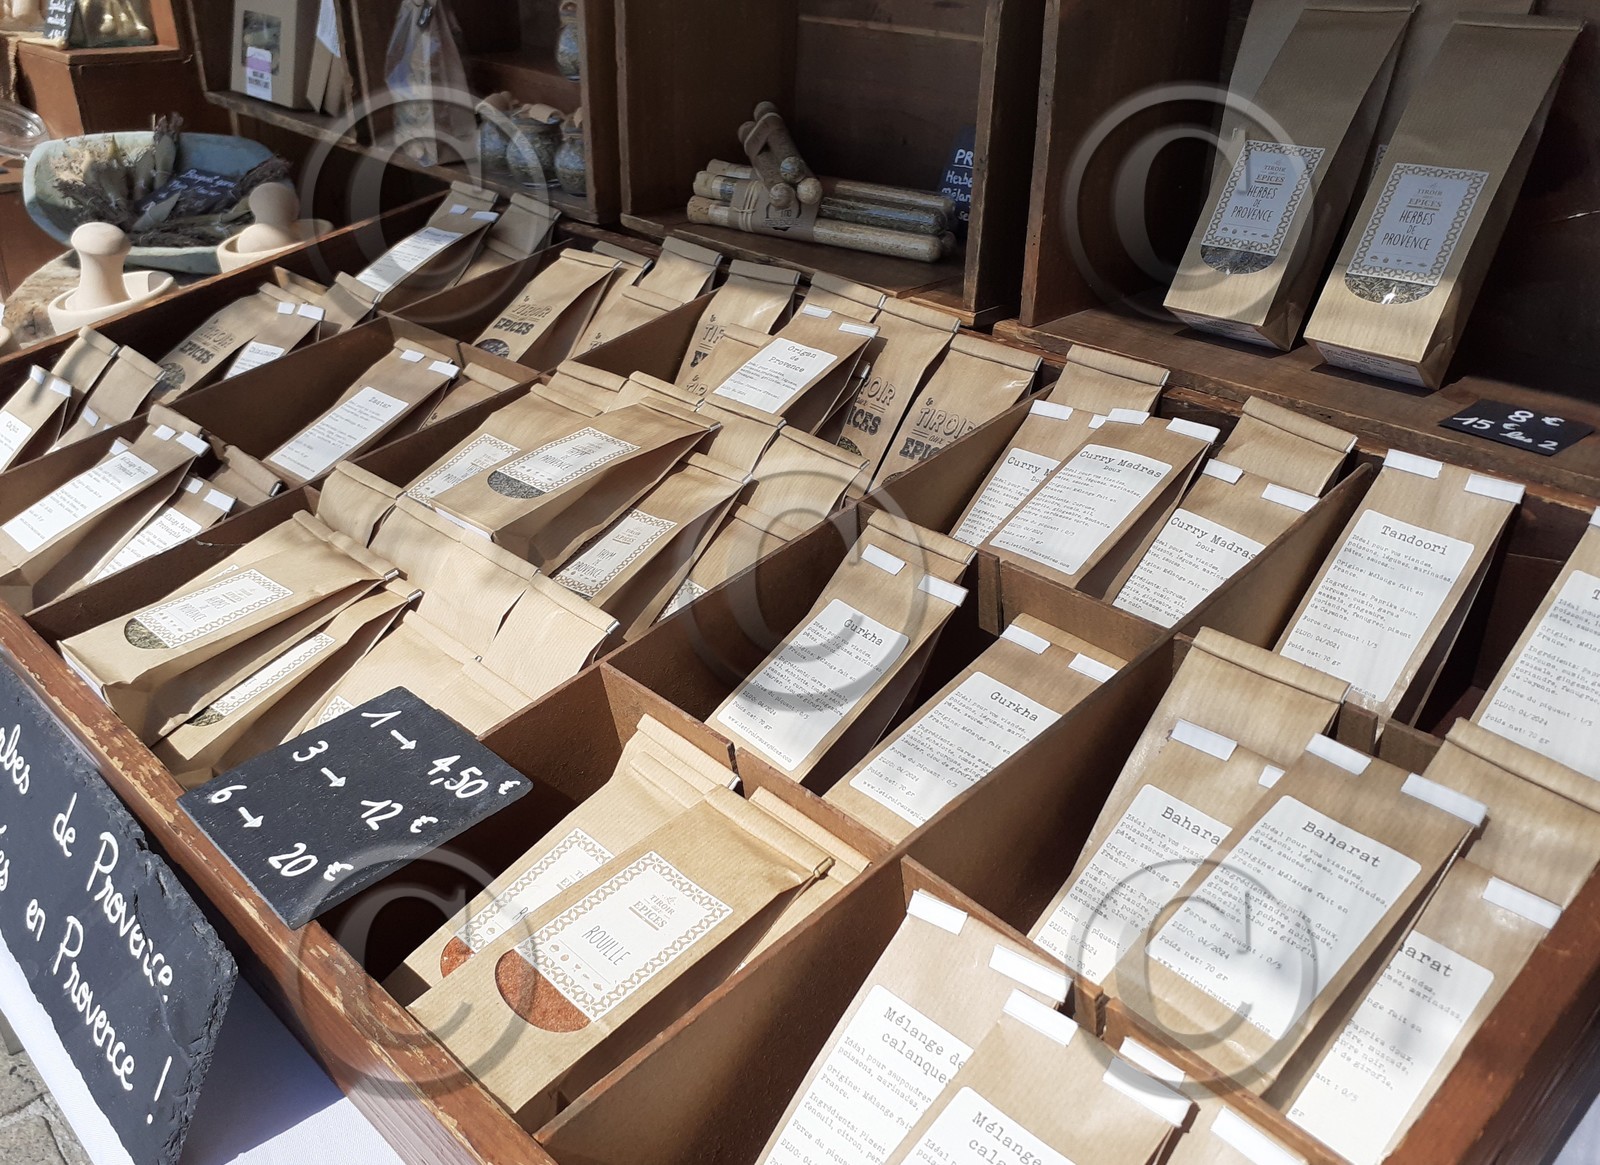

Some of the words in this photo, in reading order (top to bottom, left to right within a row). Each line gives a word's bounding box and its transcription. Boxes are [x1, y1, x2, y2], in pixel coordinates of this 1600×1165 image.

[1247, 185, 1278, 199] HERBES
[1253, 199, 1262, 207] DE
[1231, 206, 1274, 222] PROVENCE
[1399, 210, 1435, 226] HERBES
[1381, 232, 1432, 250] PROVENCE
[1407, 225, 1416, 234] DE
[493, 318, 535, 335] EPICES
[768, 356, 804, 372] Provence
[787, 345, 816, 359] Origan
[1508, 410, 1534, 422] 8
[1541, 416, 1566, 426] €
[1452, 416, 1495, 430] 15
[1538, 440, 1558, 450] 2
[1004, 456, 1041, 474] Curry
[1077, 450, 1117, 465] Curry
[1117, 460, 1166, 477] Madras
[1102, 465, 1123, 473] Doux
[1167, 516, 1209, 540] Curry
[1210, 534, 1259, 561] Madras
[1194, 541, 1217, 553] Doux
[1379, 525, 1451, 555] Tandoori
[841, 618, 886, 646] Gurkha
[988, 691, 1043, 722] Gurkha
[361, 710, 402, 728] 1
[427, 754, 489, 798] 4,50
[498, 780, 522, 796] €
[292, 740, 330, 762] 3
[360, 800, 404, 830] 12
[410, 815, 440, 834] €
[53, 792, 78, 858] de
[208, 784, 248, 804] 6
[268, 842, 319, 877] 20
[323, 860, 354, 882] €
[1301, 820, 1385, 868] Baharat
[633, 900, 668, 928] EPICES
[650, 894, 675, 916] TIROIR
[581, 924, 632, 966] ROUILLE
[26, 898, 46, 942] en
[52, 915, 134, 1092] Provence
[146, 1056, 173, 1125] !
[881, 1006, 947, 1059] Mélange
[836, 1045, 876, 1078] poissons,
[875, 1073, 921, 1111] marinades,
[842, 1036, 867, 1056] Idéal
[864, 1054, 887, 1073] pour
[886, 1068, 933, 1105] saupoudrer
[819, 1072, 852, 1099] France.
[824, 1063, 862, 1095] Origine:
[860, 1089, 896, 1120] Mélange
[791, 1118, 816, 1140] Force
[816, 1137, 828, 1150] du
[802, 1100, 837, 1130] fenouil,
[835, 1126, 866, 1153] citron,
[807, 1091, 860, 1134] Ingrédients:
[859, 1129, 888, 1155] Piment
[779, 1138, 802, 1158] DLUO:
[923, 1138, 951, 1162] Idéal
[968, 1110, 1047, 1165] Mélange
